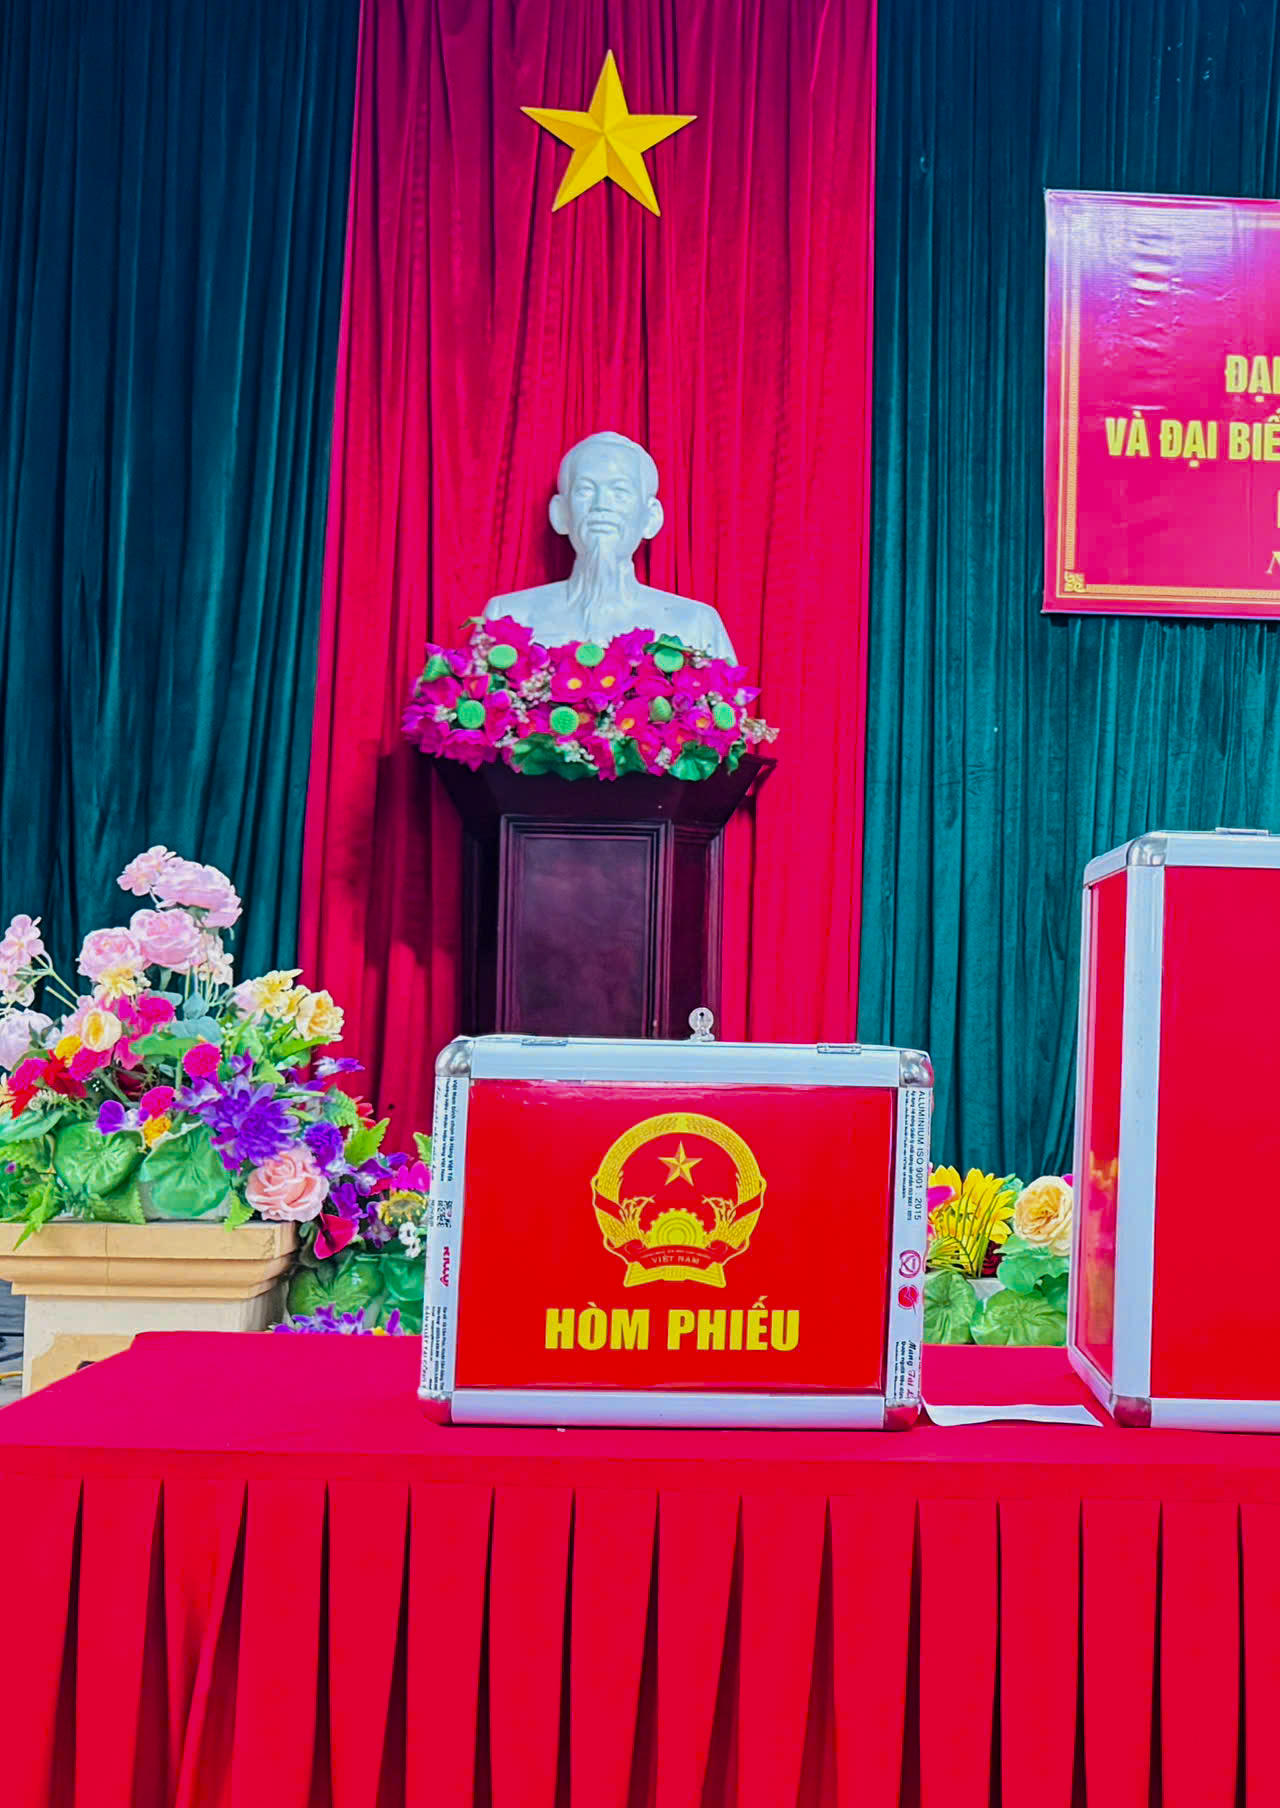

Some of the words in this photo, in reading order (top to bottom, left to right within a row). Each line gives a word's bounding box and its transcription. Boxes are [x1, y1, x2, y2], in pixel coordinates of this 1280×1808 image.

[1105, 410, 1150, 457] VÀ
[1159, 420, 1218, 467] ĐẠI
[917, 1090, 926, 1145] ALUMINIUM
[916, 1148, 925, 1165] ISO
[915, 1167, 924, 1189] 9001
[914, 1198, 923, 1221] 2015
[545, 1301, 650, 1351] HÒM
[667, 1295, 800, 1351] PHIẾU
